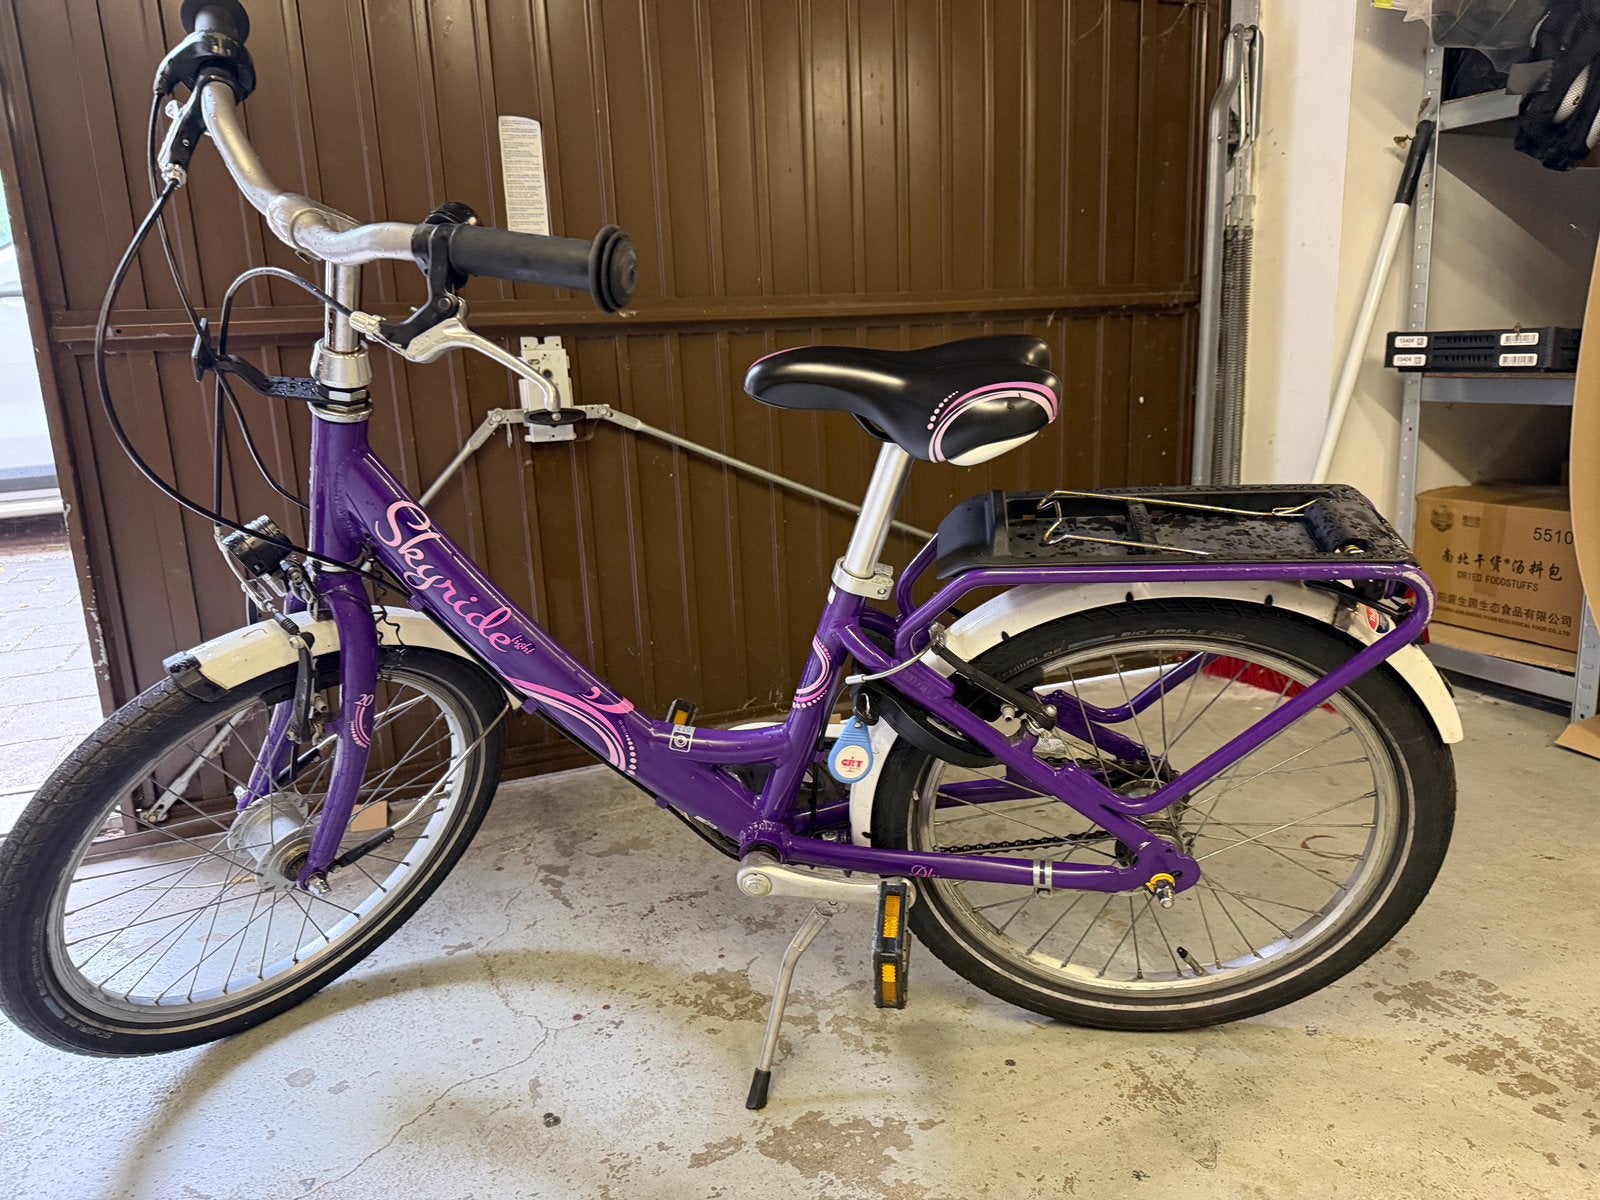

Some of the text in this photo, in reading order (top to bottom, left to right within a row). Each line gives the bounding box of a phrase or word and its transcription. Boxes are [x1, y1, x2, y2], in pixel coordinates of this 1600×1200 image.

[1532, 526, 1574, 545] 5510
[374, 499, 512, 653] Skyride
[1457, 570, 1540, 593] DRIED FOODSTUFFS
[354, 693, 375, 707] 20
